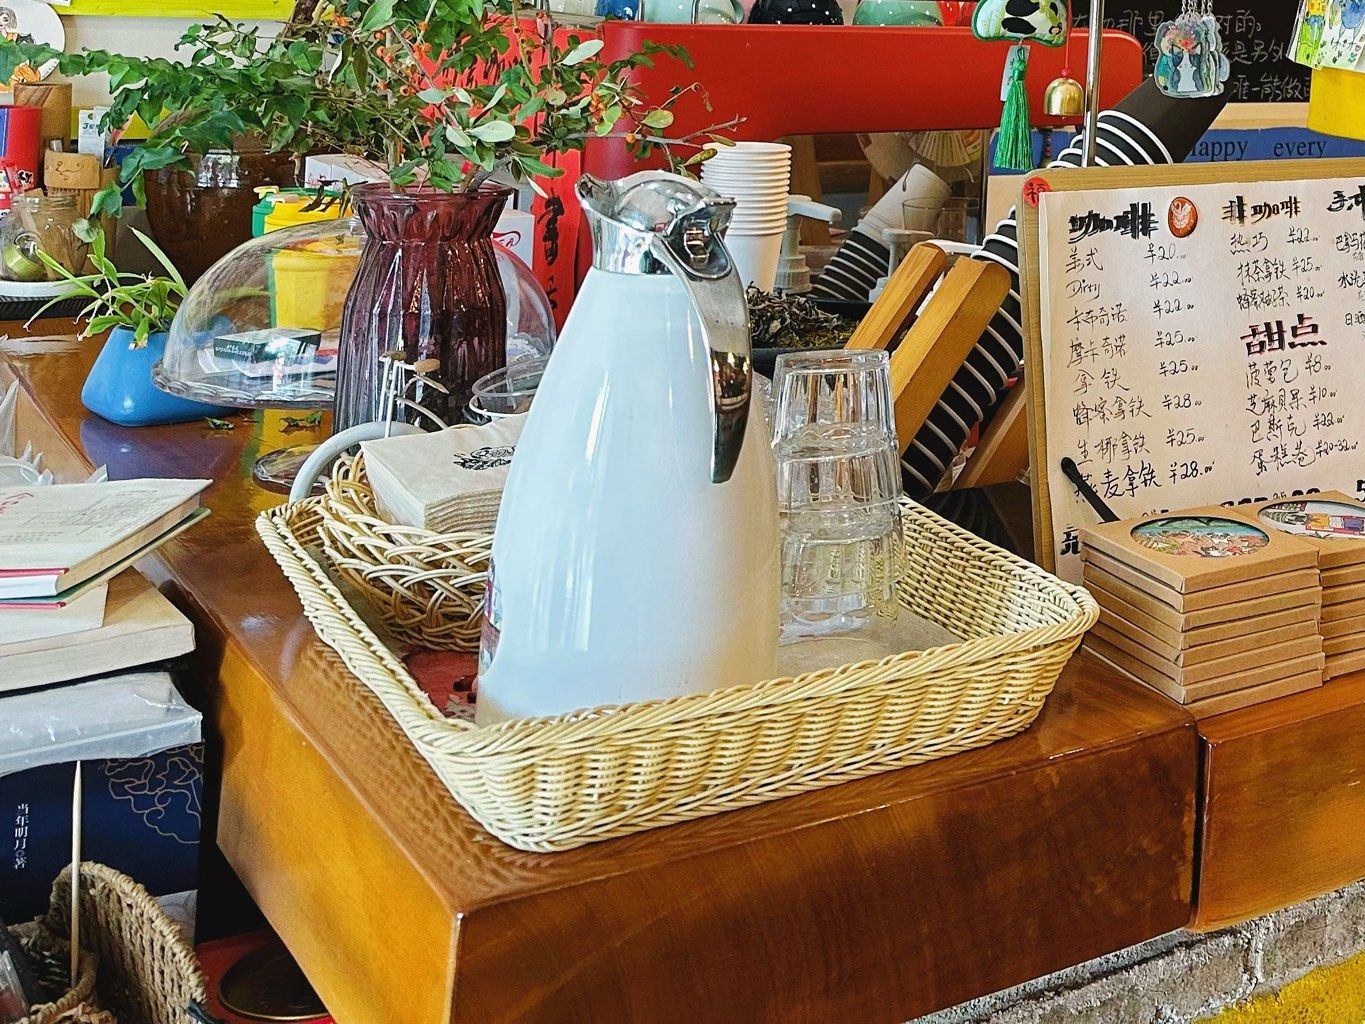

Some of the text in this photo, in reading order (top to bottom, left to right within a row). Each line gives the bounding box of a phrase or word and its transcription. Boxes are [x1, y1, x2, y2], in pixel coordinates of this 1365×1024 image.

[1273, 140, 1327, 158] every
[1065, 246, 1104, 274] 美式
[1240, 313, 1329, 356] 甜点
[1073, 368, 1130, 395] 拿铁
[1072, 395, 1152, 432] 蜂蜜拿铁
[1245, 387, 1308, 417] 芝麻贝果
[13, 803, 29, 850] 当年明月
